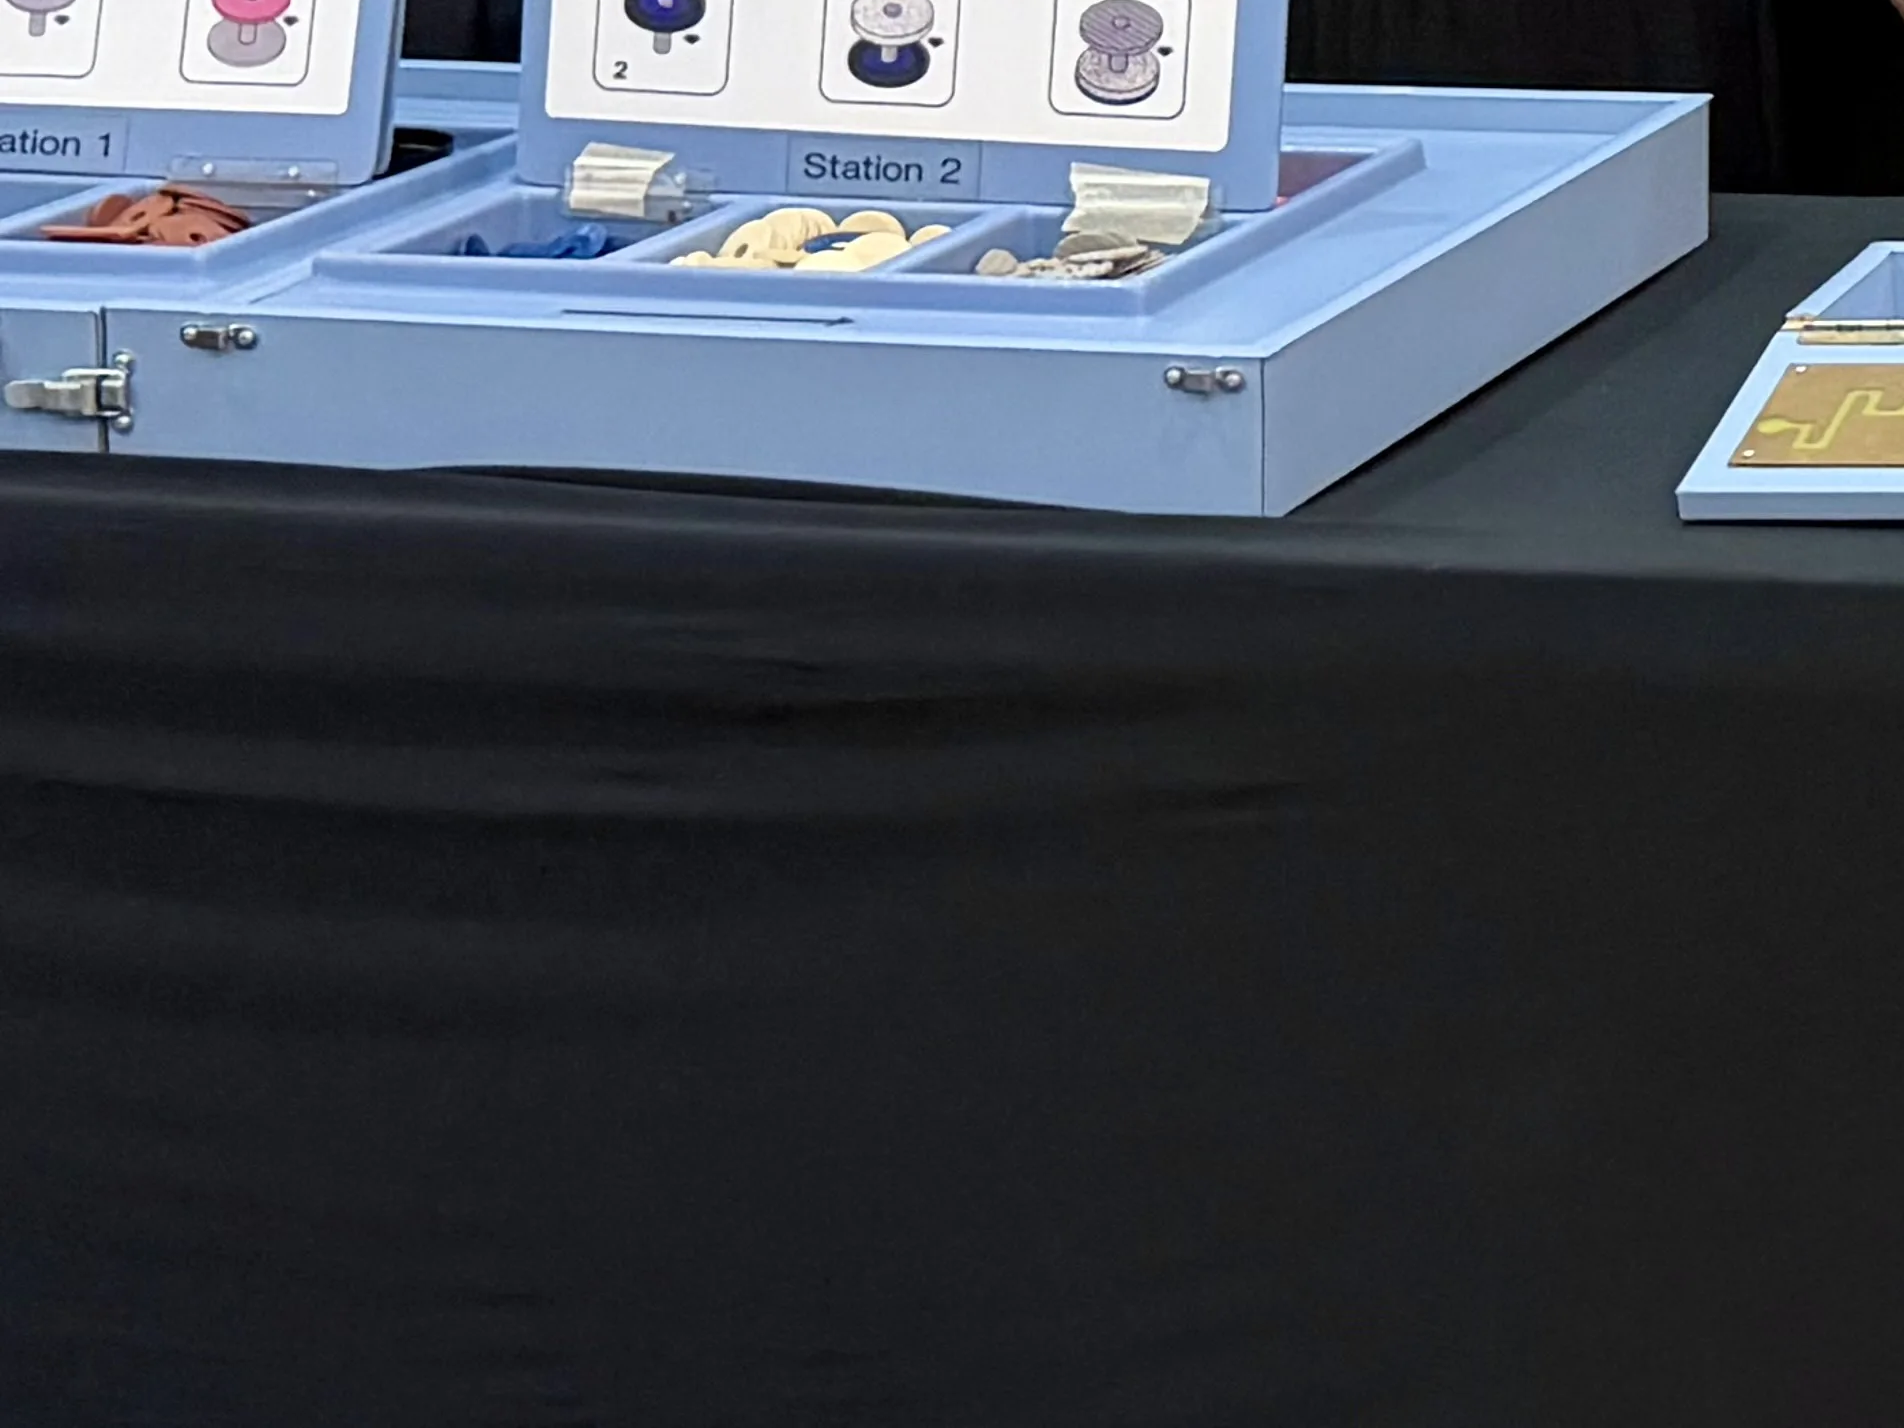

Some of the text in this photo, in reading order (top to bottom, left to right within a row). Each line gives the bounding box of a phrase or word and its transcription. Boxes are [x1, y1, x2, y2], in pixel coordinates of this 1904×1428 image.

[612, 60, 628, 80] 2
[98, 132, 111, 158] 1
[803, 152, 962, 185] Station 2
